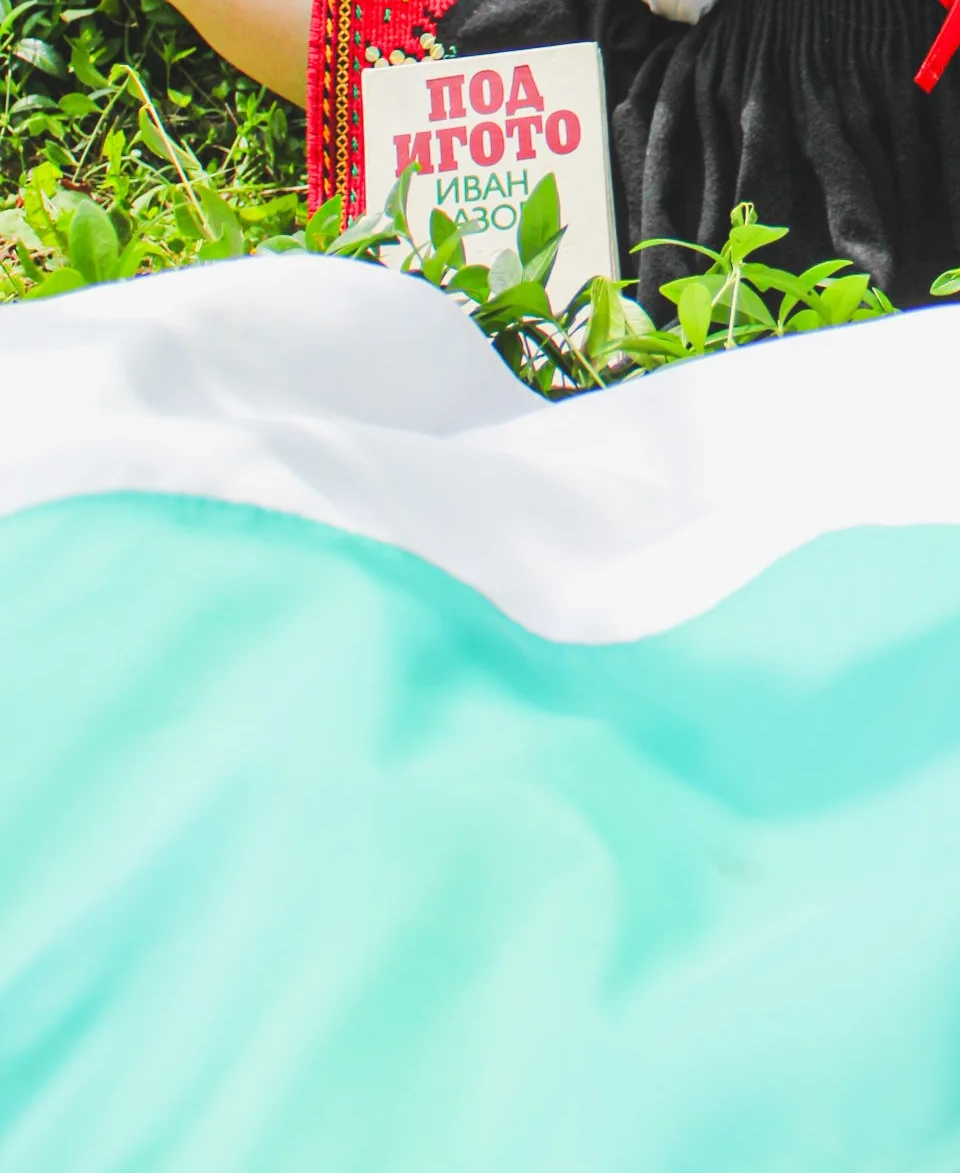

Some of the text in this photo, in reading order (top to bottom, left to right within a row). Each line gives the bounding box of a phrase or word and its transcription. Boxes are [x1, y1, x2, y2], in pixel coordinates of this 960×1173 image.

[426, 64, 544, 122] ПОД
[393, 109, 581, 178] ИГОТО
[436, 169, 529, 205] ИВАН
[452, 201, 527, 234] АЗО
